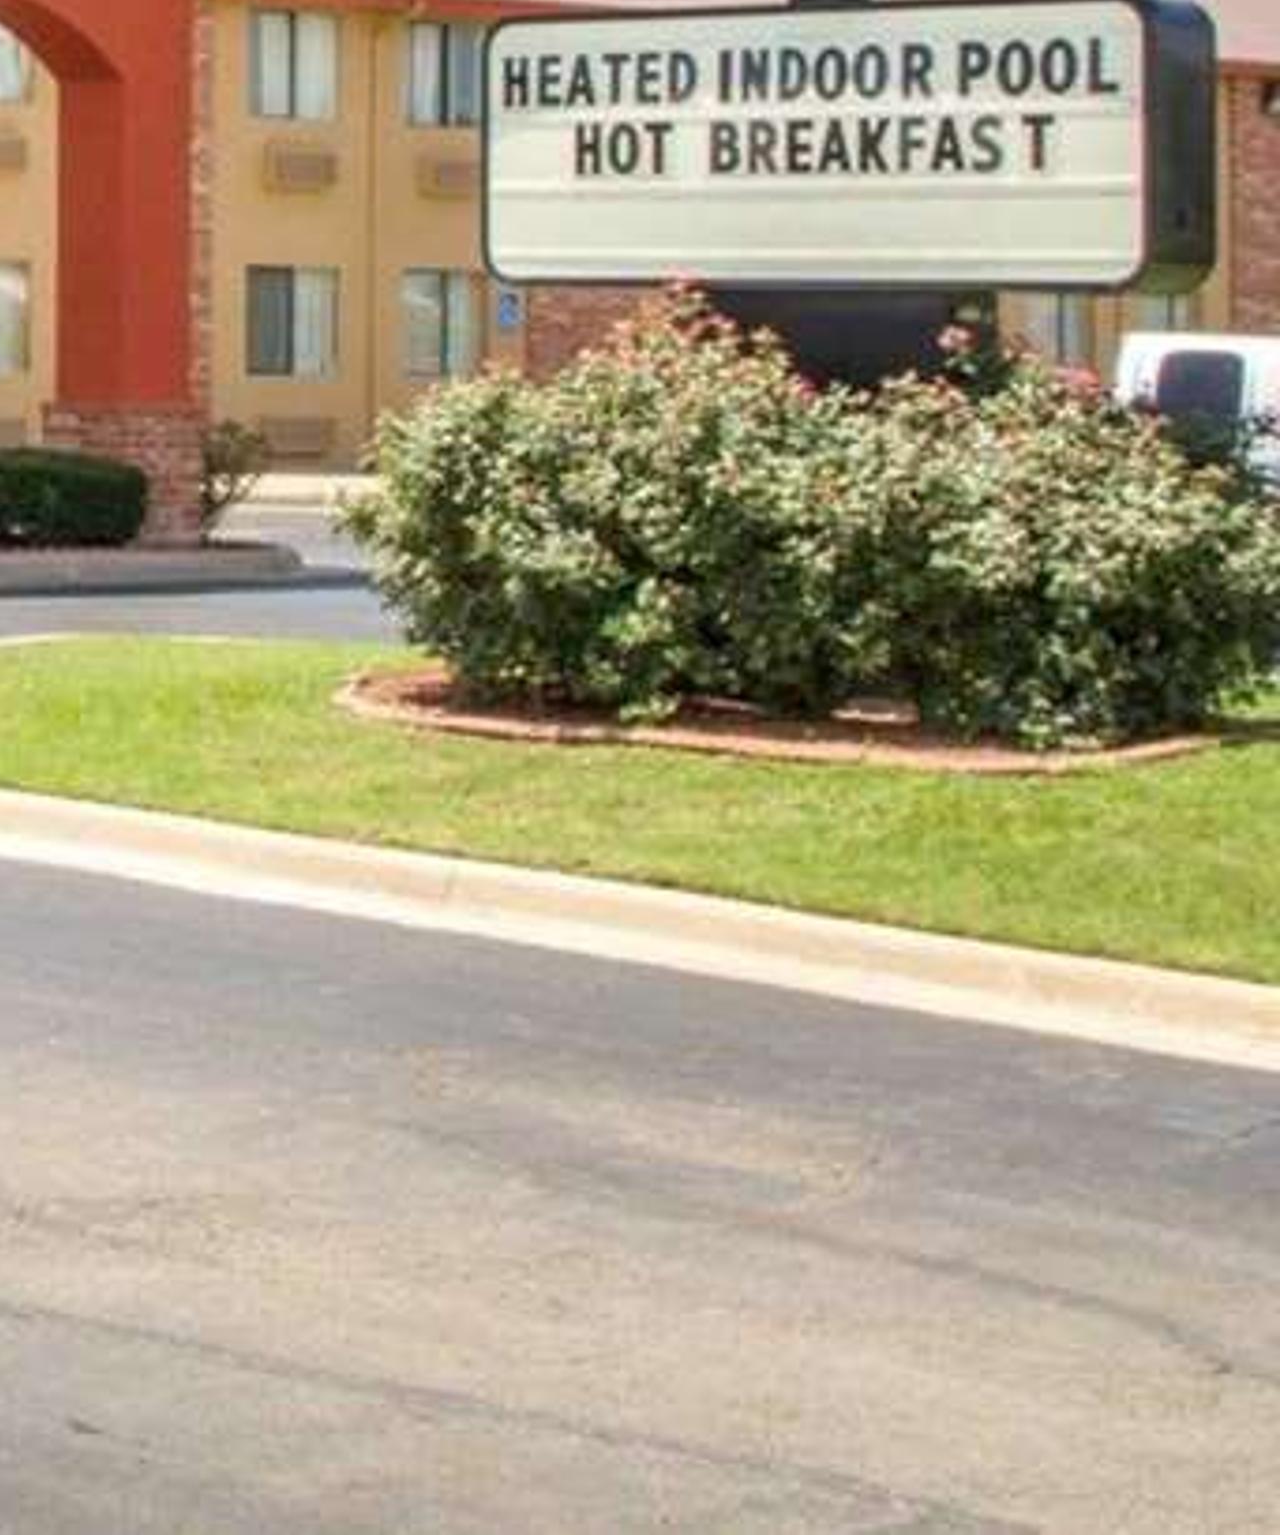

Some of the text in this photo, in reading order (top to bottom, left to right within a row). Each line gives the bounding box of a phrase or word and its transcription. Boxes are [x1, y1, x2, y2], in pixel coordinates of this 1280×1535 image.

[501, 37, 1119, 108] HEATED INDOOR POOL
[573, 114, 1056, 176] HOT BREAKFAST
